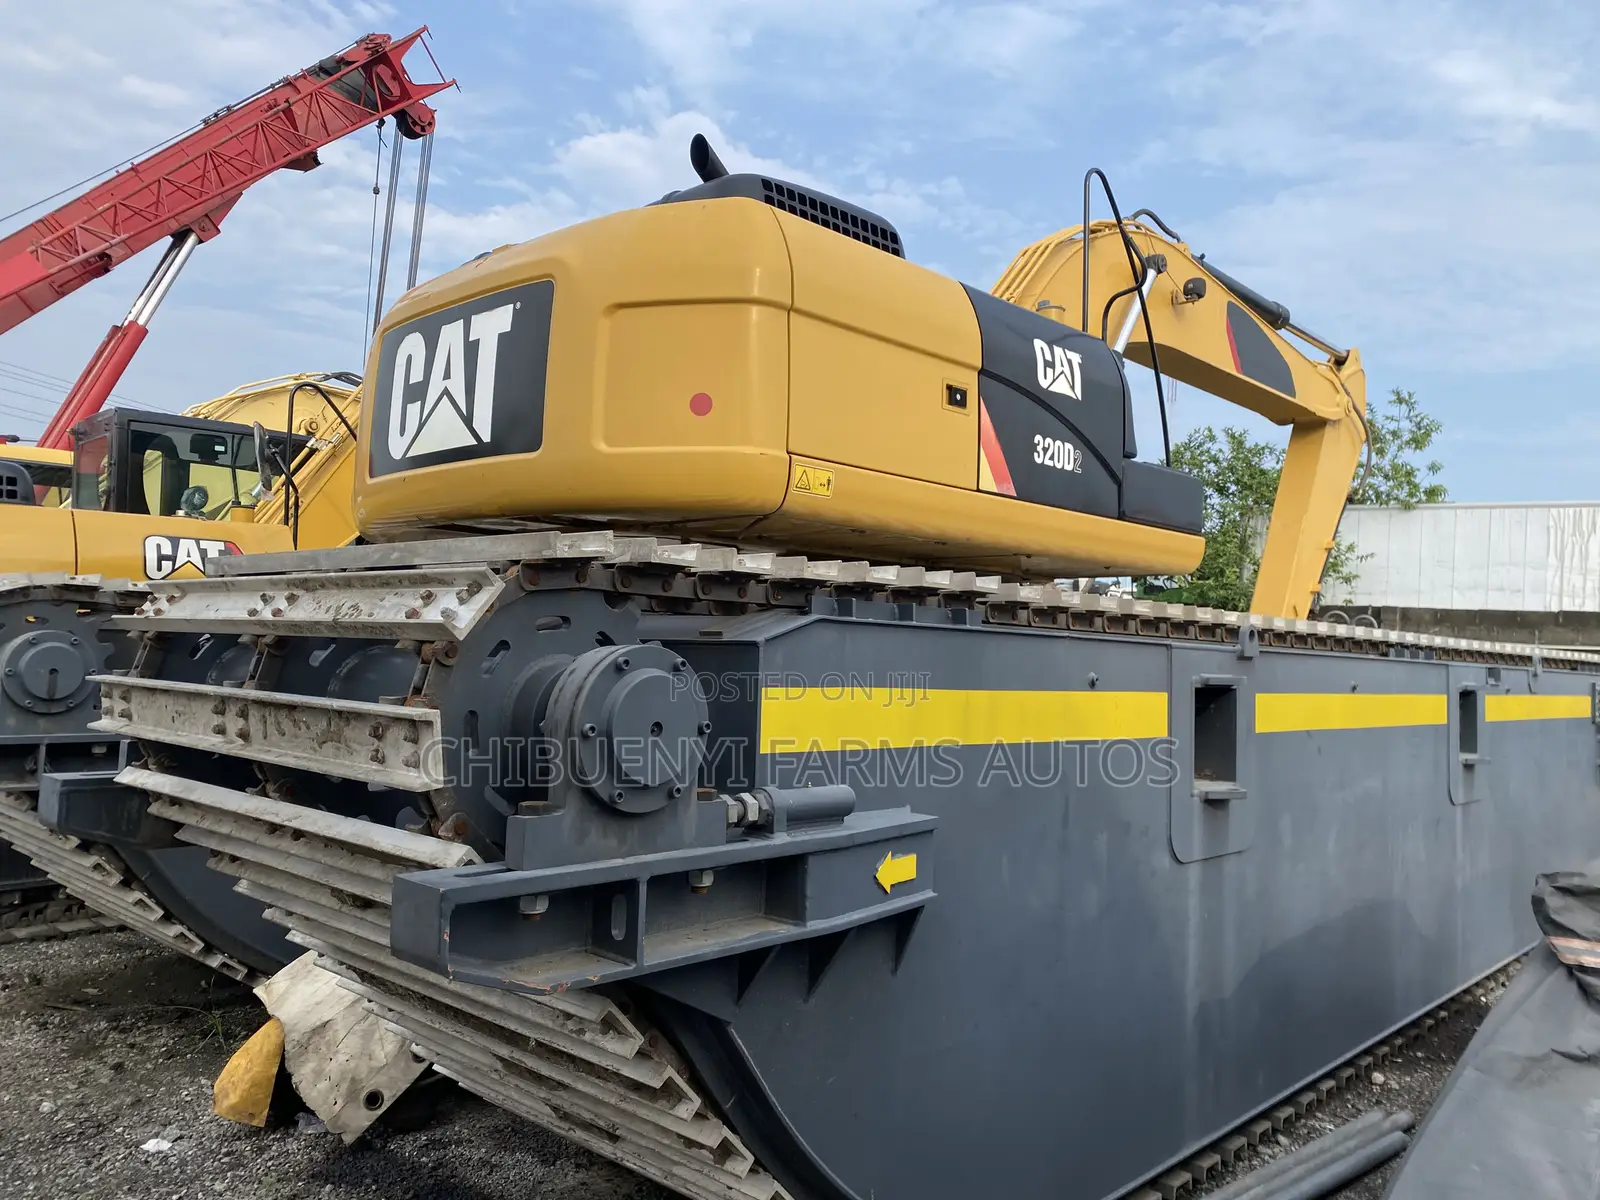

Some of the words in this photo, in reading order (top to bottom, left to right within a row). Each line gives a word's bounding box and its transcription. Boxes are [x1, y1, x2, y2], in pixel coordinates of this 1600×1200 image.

[388, 303, 514, 460] CAT
[1033, 338, 1082, 401] CAT
[1033, 434, 1083, 474] 320D2
